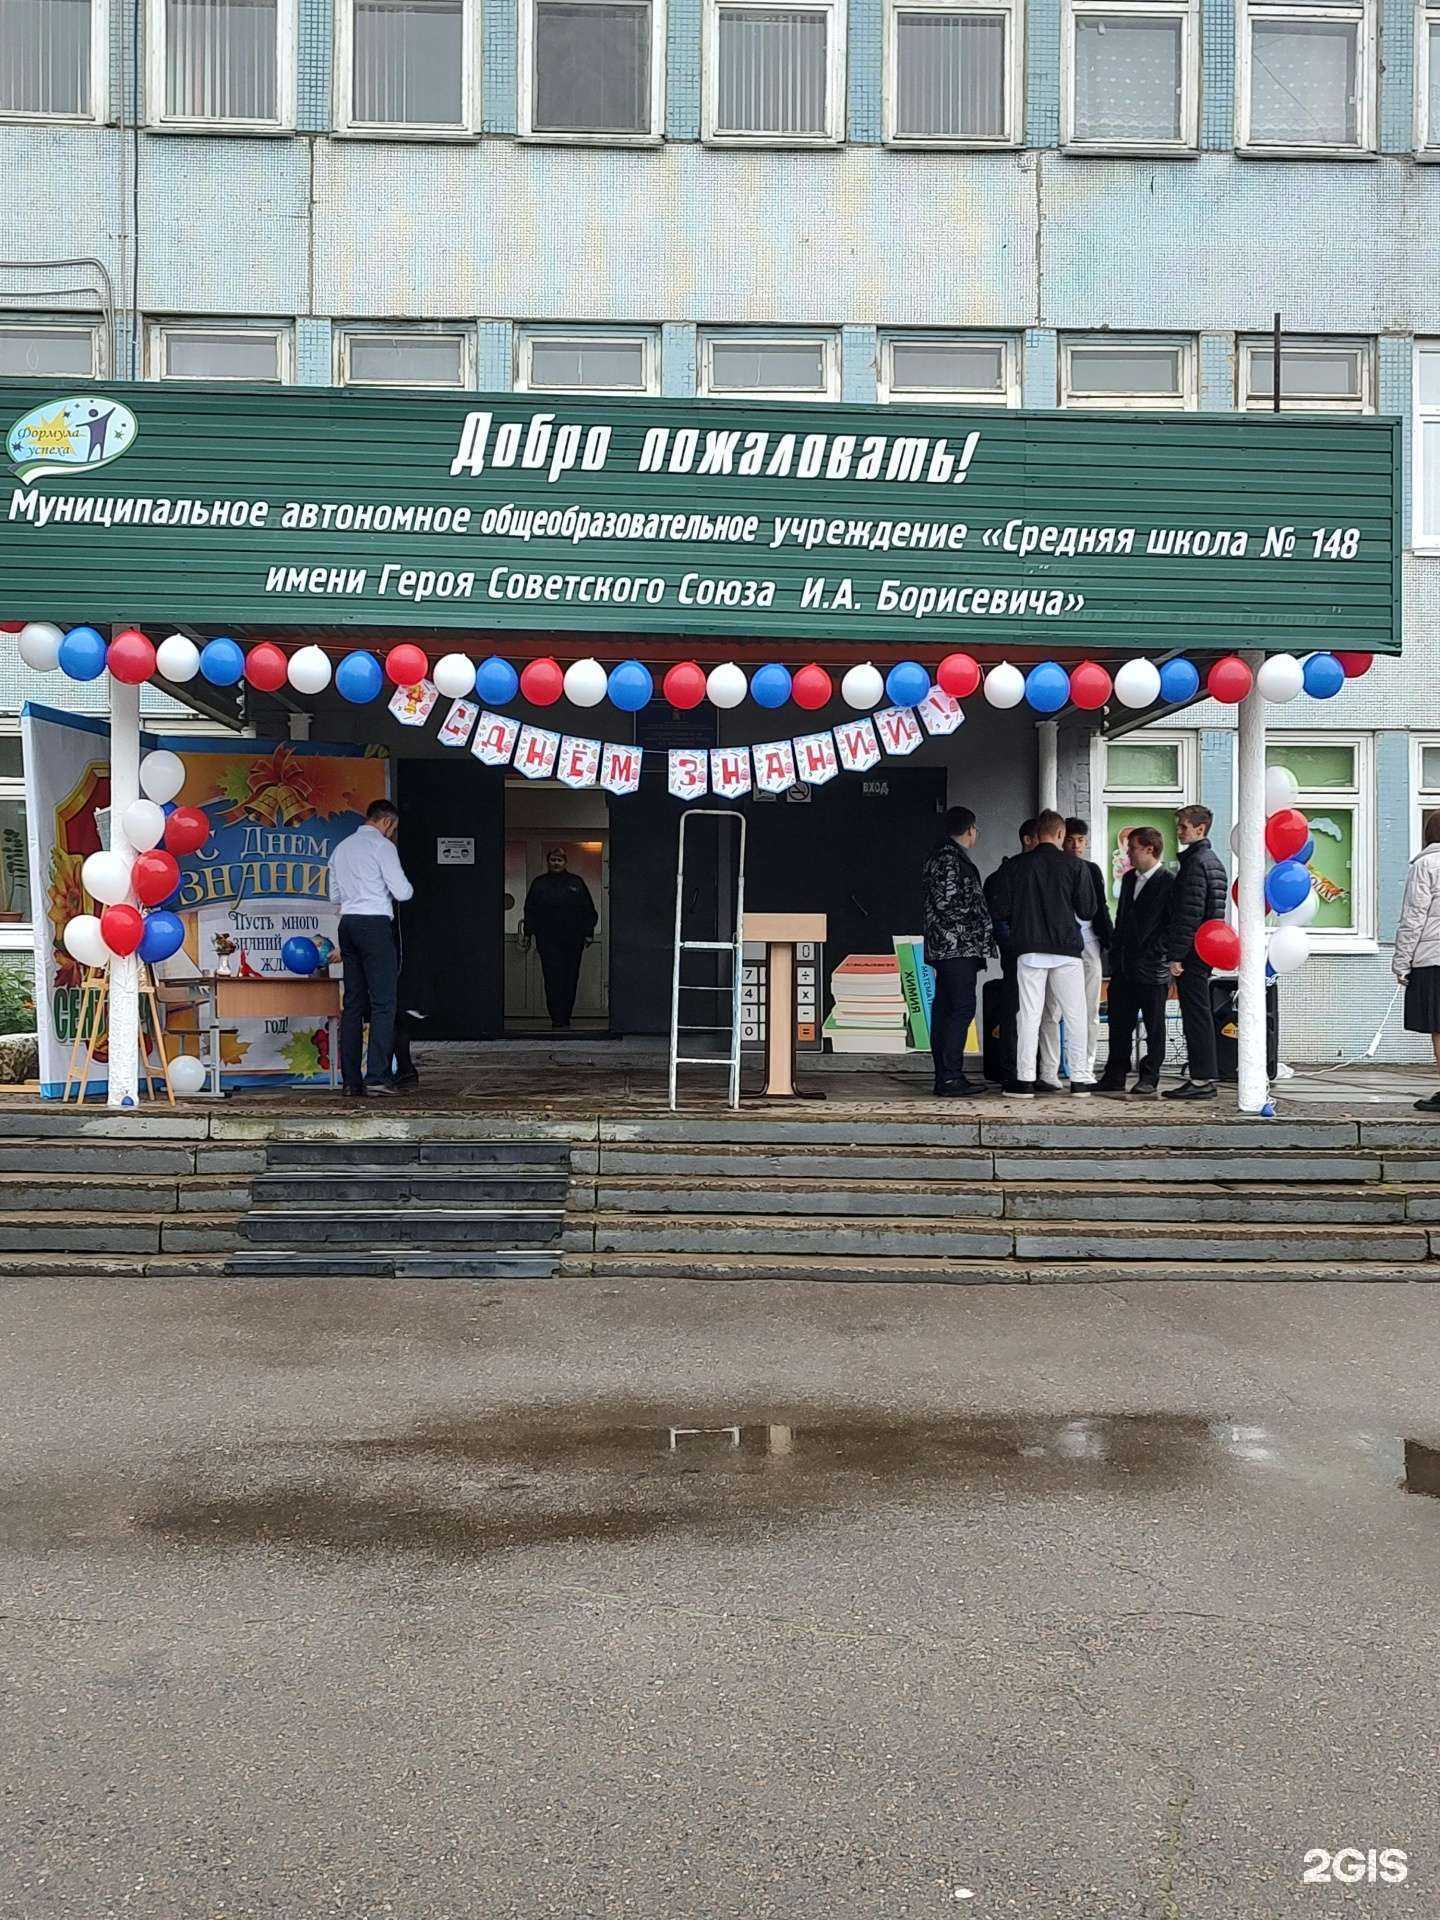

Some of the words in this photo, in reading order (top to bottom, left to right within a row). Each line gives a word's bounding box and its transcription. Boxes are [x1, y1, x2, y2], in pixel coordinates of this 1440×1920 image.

[450, 412, 611, 483] Добро
[639, 428, 981, 484] пожаловать!
[8, 488, 269, 528] Муниципальное
[281, 500, 471, 534] автономное
[480, 502, 759, 545] общеобразовательное
[768, 515, 968, 553] учреждение
[981, 519, 1134, 559] «Средняя
[1146, 529, 1248, 557] школа
[1259, 525, 1296, 559] №
[1312, 528, 1361, 561] 148
[265, 566, 367, 594] имени
[377, 563, 475, 601] Героя
[488, 566, 665, 605] Советского
[678, 573, 776, 608] Союза
[801, 578, 860, 612] И.А.
[877, 579, 1085, 620] Борисевича»
[862, 782, 889, 796] ВХОД
[180, 861, 329, 911] ЗНАНИ
[744, 989, 753, 998] 4
[745, 969, 753, 979] 7
[904, 970, 921, 1014] ХИМИЯ
